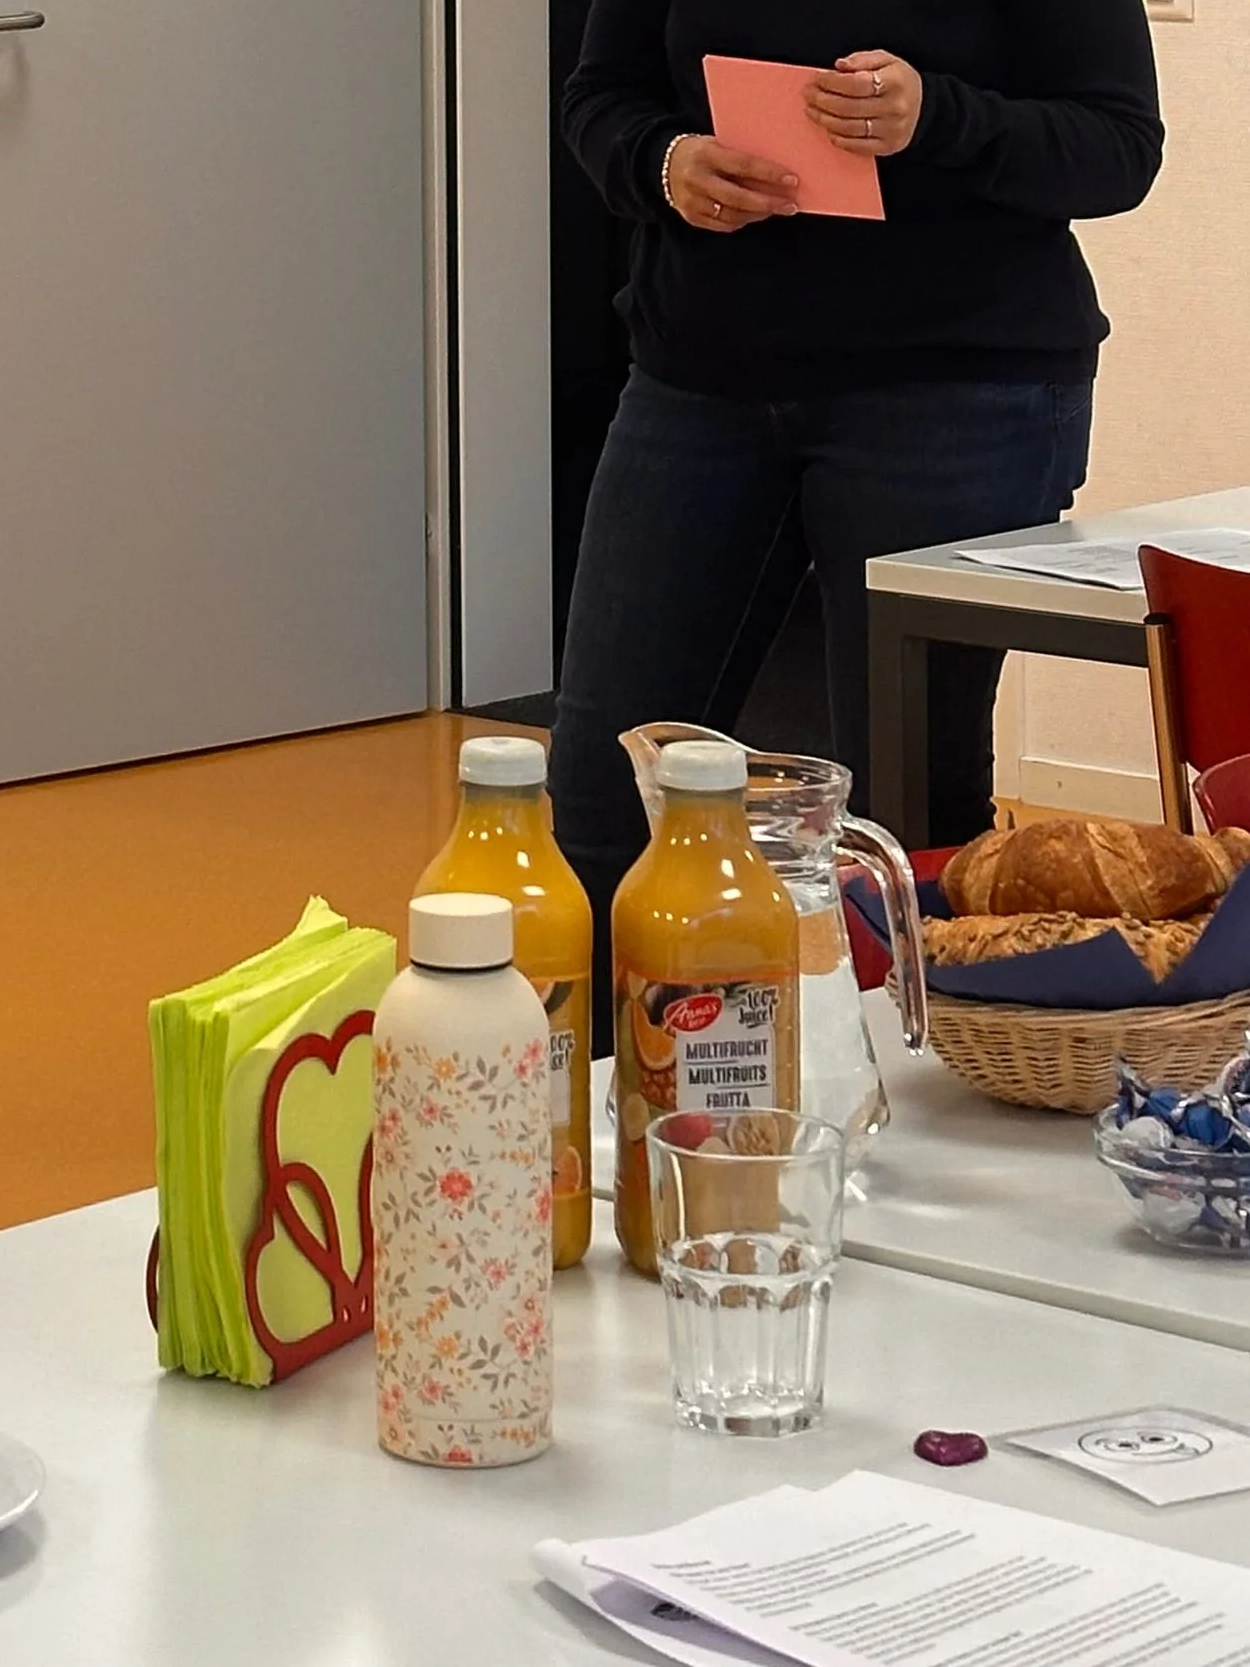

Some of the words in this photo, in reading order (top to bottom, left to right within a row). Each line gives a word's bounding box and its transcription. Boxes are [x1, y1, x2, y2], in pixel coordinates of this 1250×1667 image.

[550, 1032, 574, 1052] 00%
[686, 1039, 768, 1060] MULTIFRUCHT
[688, 1065, 767, 1085] MULTIFRUITS
[706, 1092, 751, 1108] FRUTTA
